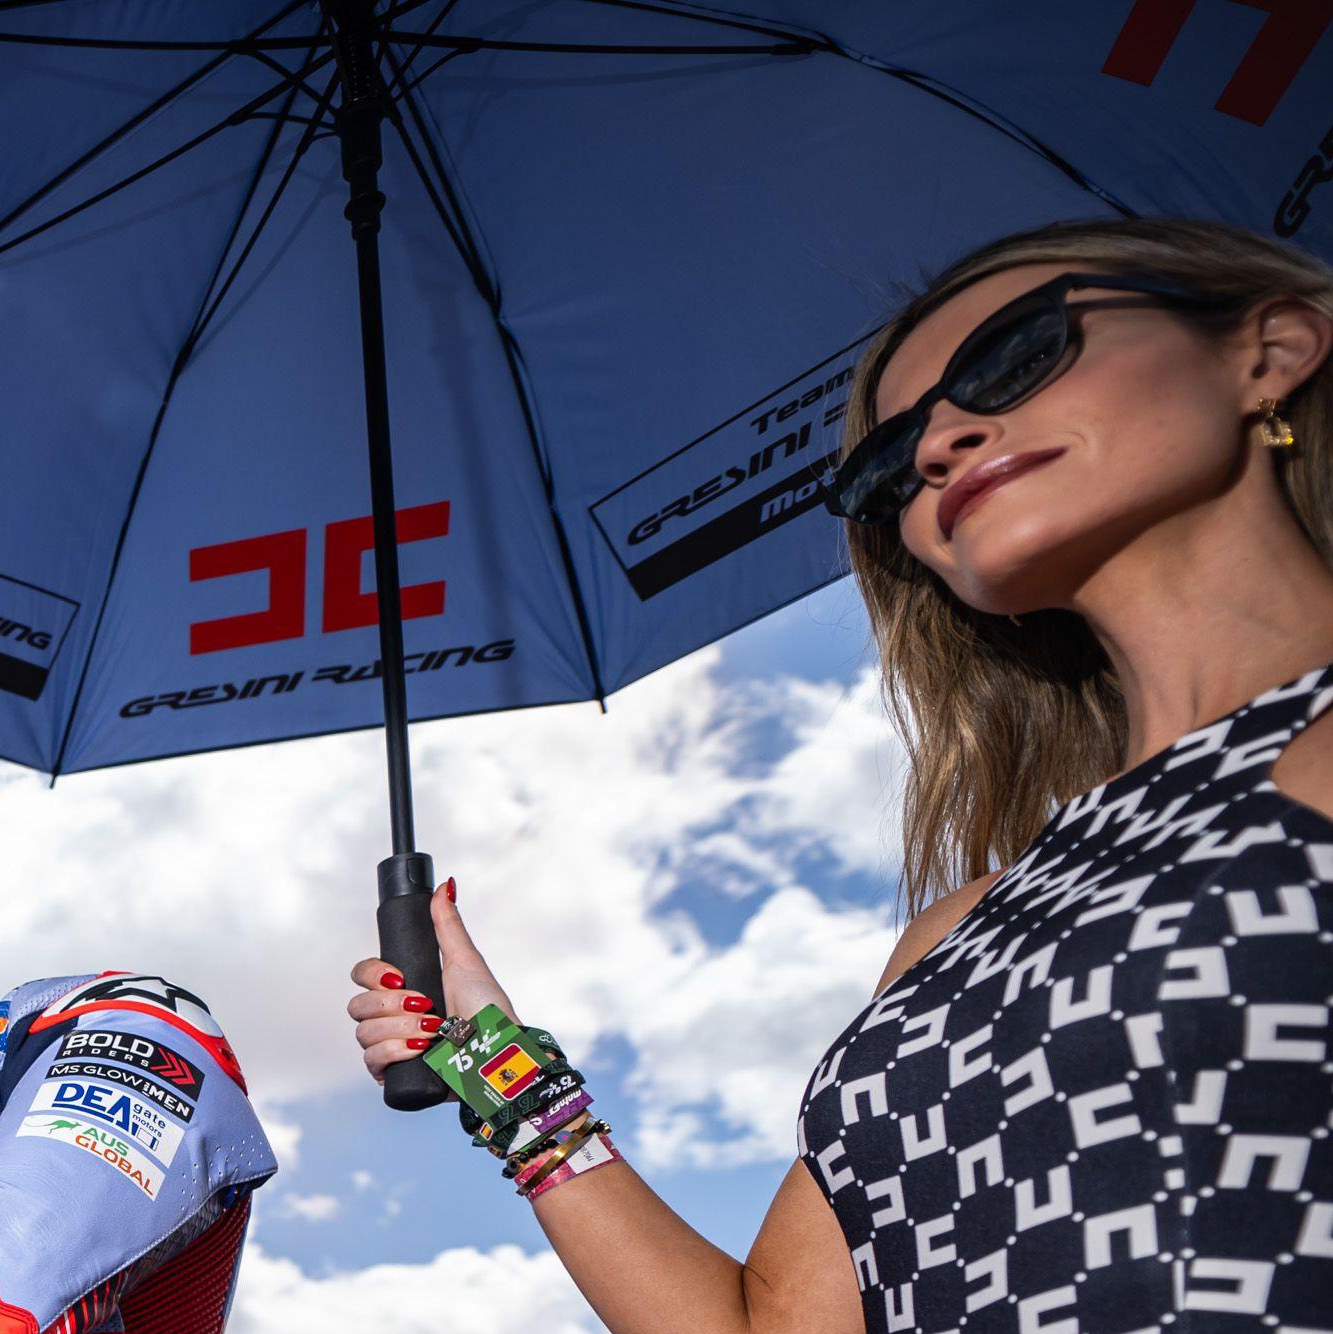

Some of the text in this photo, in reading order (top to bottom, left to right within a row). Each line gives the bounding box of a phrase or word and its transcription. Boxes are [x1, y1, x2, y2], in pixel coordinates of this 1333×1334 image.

[627, 421, 812, 546] GRESINI
[119, 670, 304, 718] GRESINI
[62, 1048, 150, 1068] RIDERS
[66, 1033, 155, 1058] BOLD
[51, 1064, 80, 1076] MS
[83, 1066, 143, 1087] GLOW
[150, 1086, 191, 1118] MEN
[53, 1083, 132, 1132] DEA
[133, 1104, 166, 1129] gate
[133, 1114, 163, 1138] motors
[83, 1127, 130, 1156] AUS
[75, 1135, 155, 1196] GLOBAL
